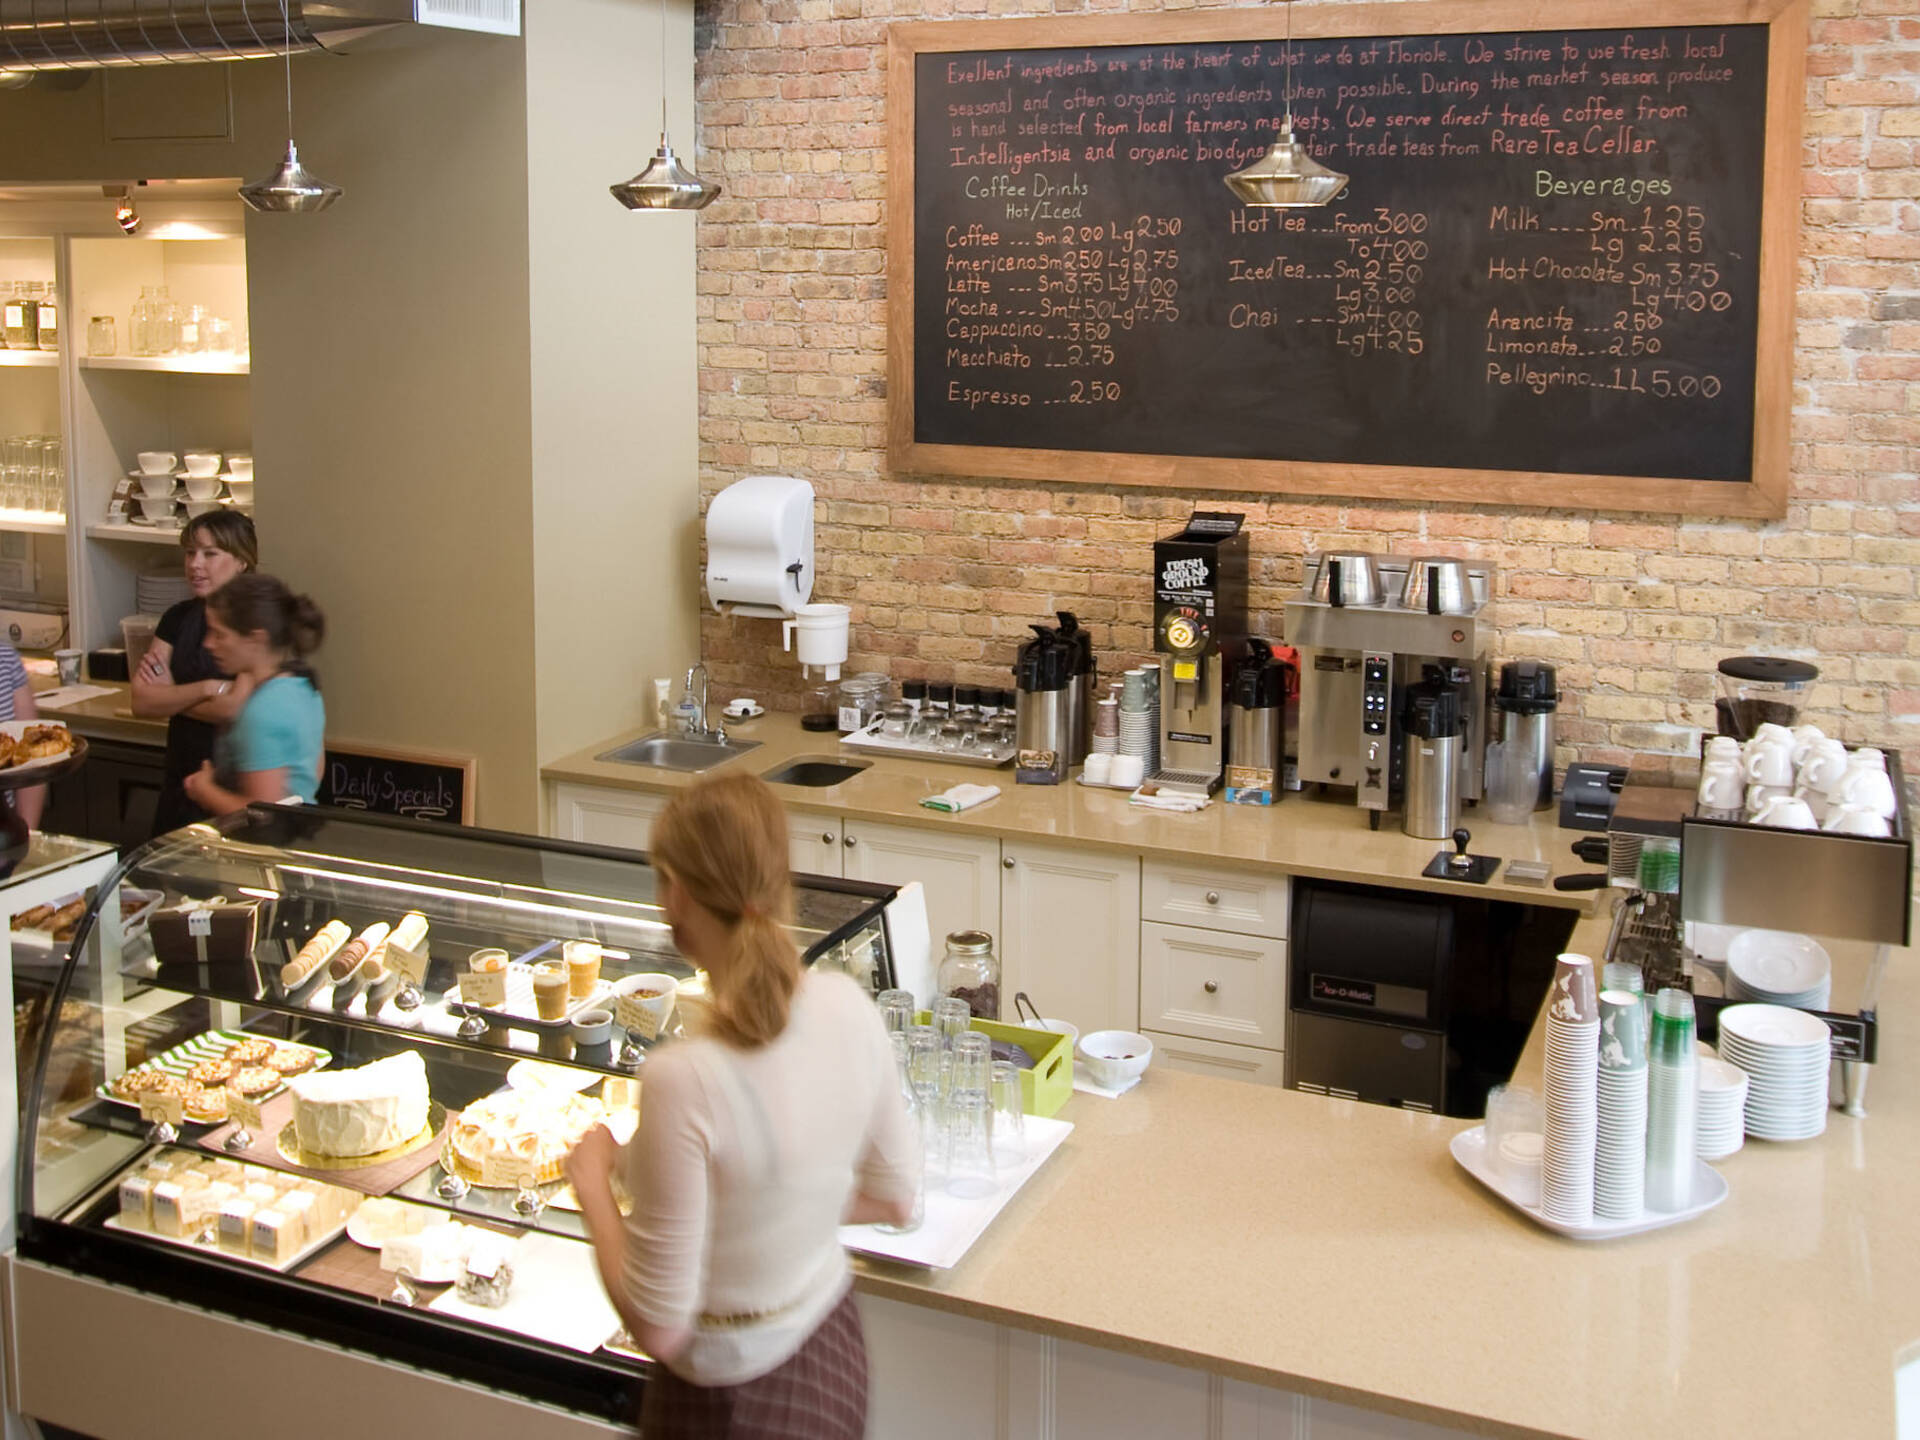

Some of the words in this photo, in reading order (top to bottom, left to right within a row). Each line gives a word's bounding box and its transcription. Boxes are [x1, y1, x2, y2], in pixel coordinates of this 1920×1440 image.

[948, 56, 1014, 84] Exellent
[1021, 53, 1098, 84] ingredients
[1108, 60, 1128, 72] are
[1139, 53, 1153, 71] at
[1162, 49, 1185, 70] the
[1193, 47, 1232, 69] heart
[1242, 46, 1261, 67] of
[1268, 45, 1306, 66] what
[1315, 53, 1331, 65] we
[1336, 45, 1352, 64] do
[1360, 42, 1379, 65] at
[1464, 40, 1494, 64] We
[1504, 38, 1551, 62] strive
[1562, 37, 1578, 61] to
[1588, 46, 1615, 59] use
[1621, 34, 1671, 60] fresh
[1683, 34, 1726, 58] local
[948, 88, 1012, 116] seasonal
[1023, 90, 1052, 111] and
[1063, 87, 1105, 110] often
[1114, 89, 1176, 114] organic
[1186, 81, 1272, 110] ingredients
[1282, 79, 1326, 101] when
[1338, 73, 1412, 110] possible.
[1422, 72, 1479, 100] During
[1491, 69, 1520, 89] the
[1528, 62, 1589, 86] market
[1600, 71, 1659, 86] season
[1668, 64, 1734, 93] produce
[952, 125, 962, 137] is
[970, 119, 1006, 137] hand
[1019, 112, 1086, 135] selected
[1094, 112, 1128, 135] from
[1137, 109, 1174, 133] local
[1185, 110, 1247, 133] farmers
[1255, 106, 1335, 131] makets.
[1346, 105, 1376, 127] We
[1385, 114, 1432, 127] serve
[1441, 104, 1492, 125] direct
[1501, 103, 1550, 128] trade
[1562, 96, 1624, 122] coffee
[1637, 95, 1688, 120] from
[950, 140, 1071, 174] Intelligentsia
[1085, 137, 1116, 160] and
[1129, 145, 1189, 165] organic
[1307, 133, 1338, 156] fair
[1348, 131, 1397, 156] trade
[1403, 133, 1435, 156] teas
[1440, 132, 1480, 156] from
[1490, 129, 1538, 154] Rare
[1541, 129, 1578, 156] Tea
[965, 175, 1026, 199] Coffee
[1033, 172, 1088, 197] Drinks
[1535, 170, 1673, 205] Beverages
[1006, 200, 1082, 221] Hot/Iced
[1230, 208, 1269, 234] Hot
[1274, 208, 1306, 232] Tea
[1489, 205, 1540, 231] Milk
[1590, 211, 1628, 231] Sm
[1640, 205, 1705, 231] 1.25
[946, 224, 999, 248] Coffee
[1035, 232, 1057, 246] Sm
[1111, 221, 1134, 253] Lg
[1137, 215, 1182, 238] 2.50
[1347, 238, 1370, 258] To
[1591, 233, 1624, 263] Lg
[1638, 230, 1703, 253] 2.25
[1037, 254, 1062, 270] Sm
[1108, 250, 1130, 281] Lg
[1133, 249, 1179, 272] 2.75
[1228, 259, 1275, 281] Iced
[1275, 256, 1305, 279] Tea
[1334, 260, 1360, 280] Sm
[1488, 257, 1529, 281] Hot
[1532, 256, 1624, 283] Chocolate
[1629, 262, 1661, 287] Sm
[948, 273, 992, 294] Latte
[1038, 275, 1064, 292] Sm
[1109, 272, 1130, 301] Lg
[1336, 284, 1361, 311] Lg
[1633, 286, 1660, 315] Lg
[1664, 286, 1732, 311] 4.00
[945, 297, 998, 317] Mocha
[1040, 297, 1068, 318] Sm
[1112, 302, 1134, 329] Lg
[1134, 296, 1179, 321] 4.75
[1229, 304, 1278, 329] Chai
[1338, 306, 1365, 324] Sm
[1366, 305, 1423, 330] 4.00
[946, 319, 1044, 344] Cappuccino
[1336, 328, 1365, 357] Lg
[1366, 325, 1424, 354] 4.25
[1487, 333, 1579, 356] Limonata
[947, 344, 1031, 368] Macchiato
[1068, 345, 1114, 366] 2.75
[948, 381, 1031, 410] Espresso
[1069, 380, 1120, 404] 2.50
[1487, 363, 1591, 395] Pellegrino
[1652, 370, 1721, 398] 5.00
[332, 762, 379, 806] Daily
[382, 771, 454, 811] Specials
